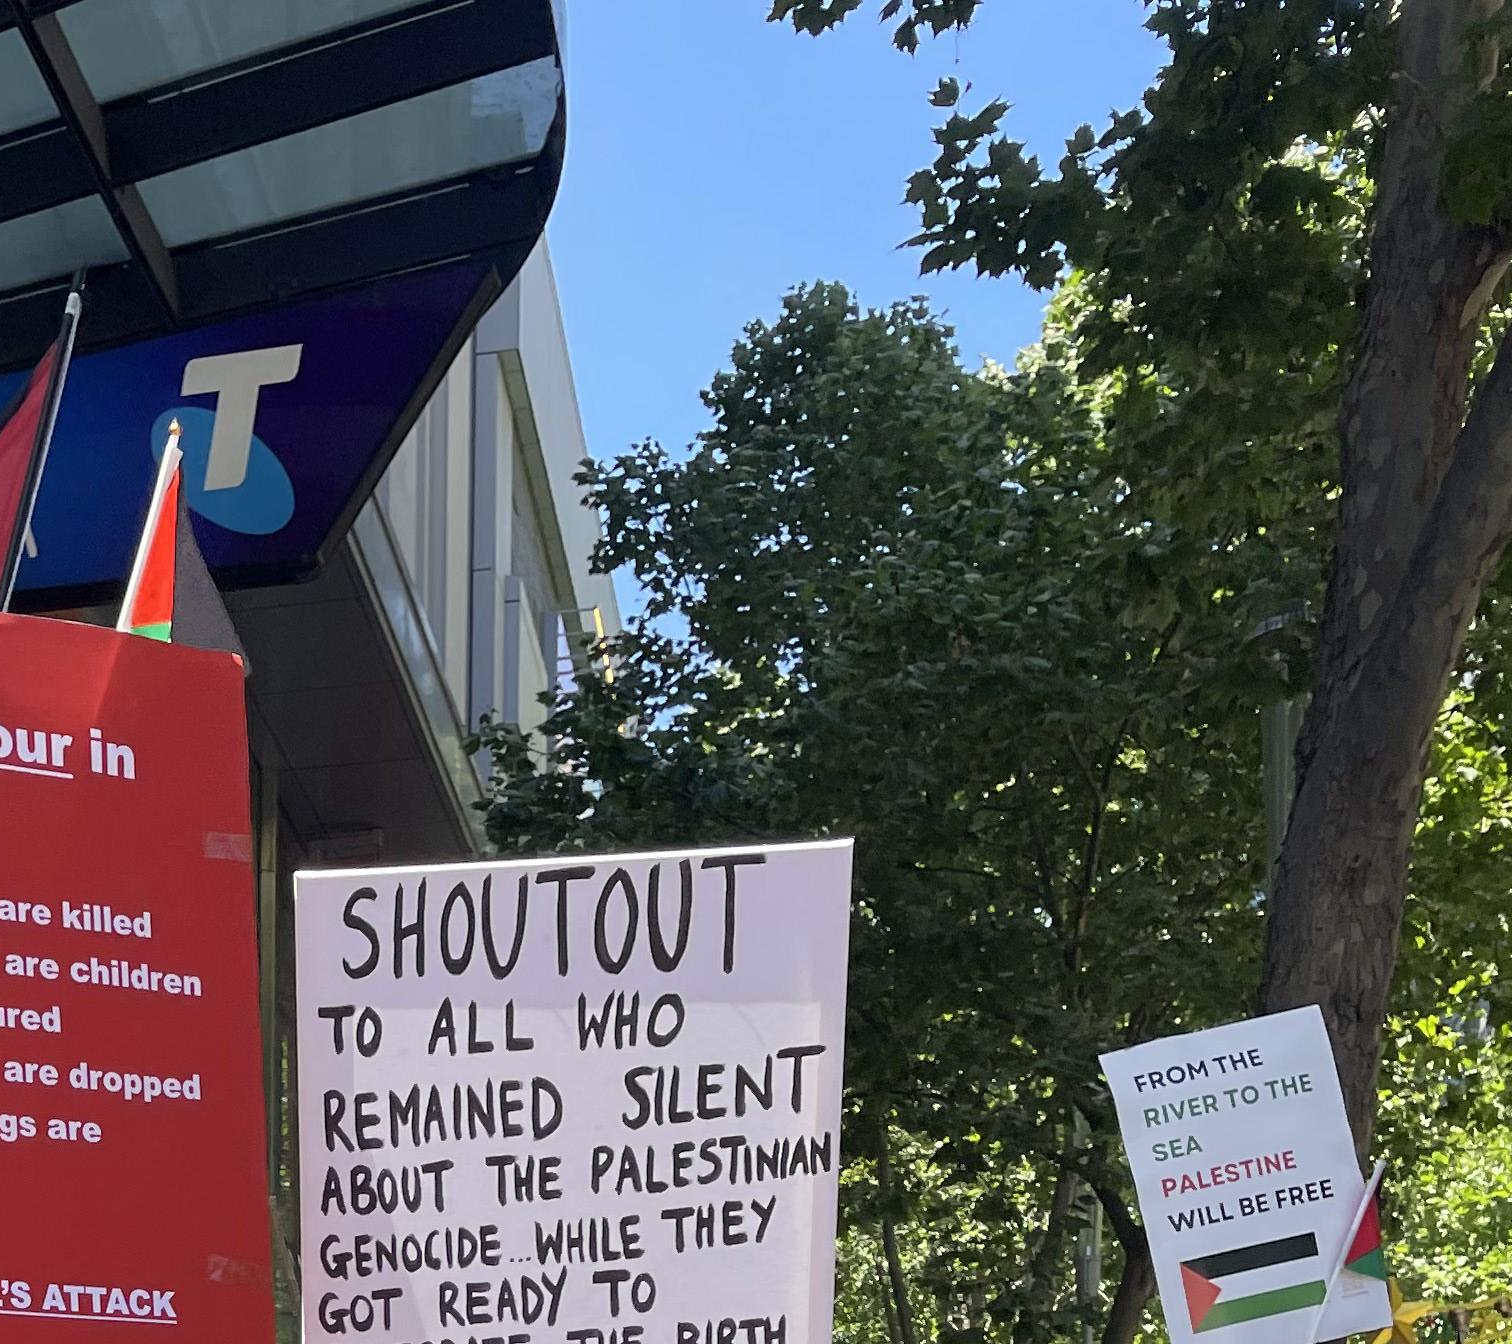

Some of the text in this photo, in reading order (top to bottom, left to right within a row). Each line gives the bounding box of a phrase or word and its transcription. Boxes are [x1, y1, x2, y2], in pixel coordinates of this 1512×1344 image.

[90, 728, 135, 779] in
[62, 901, 151, 938] killed
[343, 854, 766, 980] SHOUTOUT
[5, 954, 59, 979] are
[71, 957, 201, 996] children
[318, 990, 684, 1057] TO ALL WHO
[4, 1061, 58, 1085] are
[70, 1062, 200, 1102] dropped
[1134, 1048, 1263, 1093] FROM THE
[324, 1045, 826, 1152] REMAINED SILENT
[1144, 1073, 1313, 1128] RIVER TO THE
[48, 1119, 101, 1142] are
[1152, 1135, 1203, 1162] SEA
[321, 1132, 831, 1216] ABOUT THE PALESTINIAN
[1161, 1151, 1297, 1198] PALESTINE
[661, 1195, 777, 1253] THEY
[1168, 1179, 1334, 1232] WILL BE FREE
[42, 1284, 176, 1317] ATTACK
[319, 1266, 656, 1334] GOT READY TO
